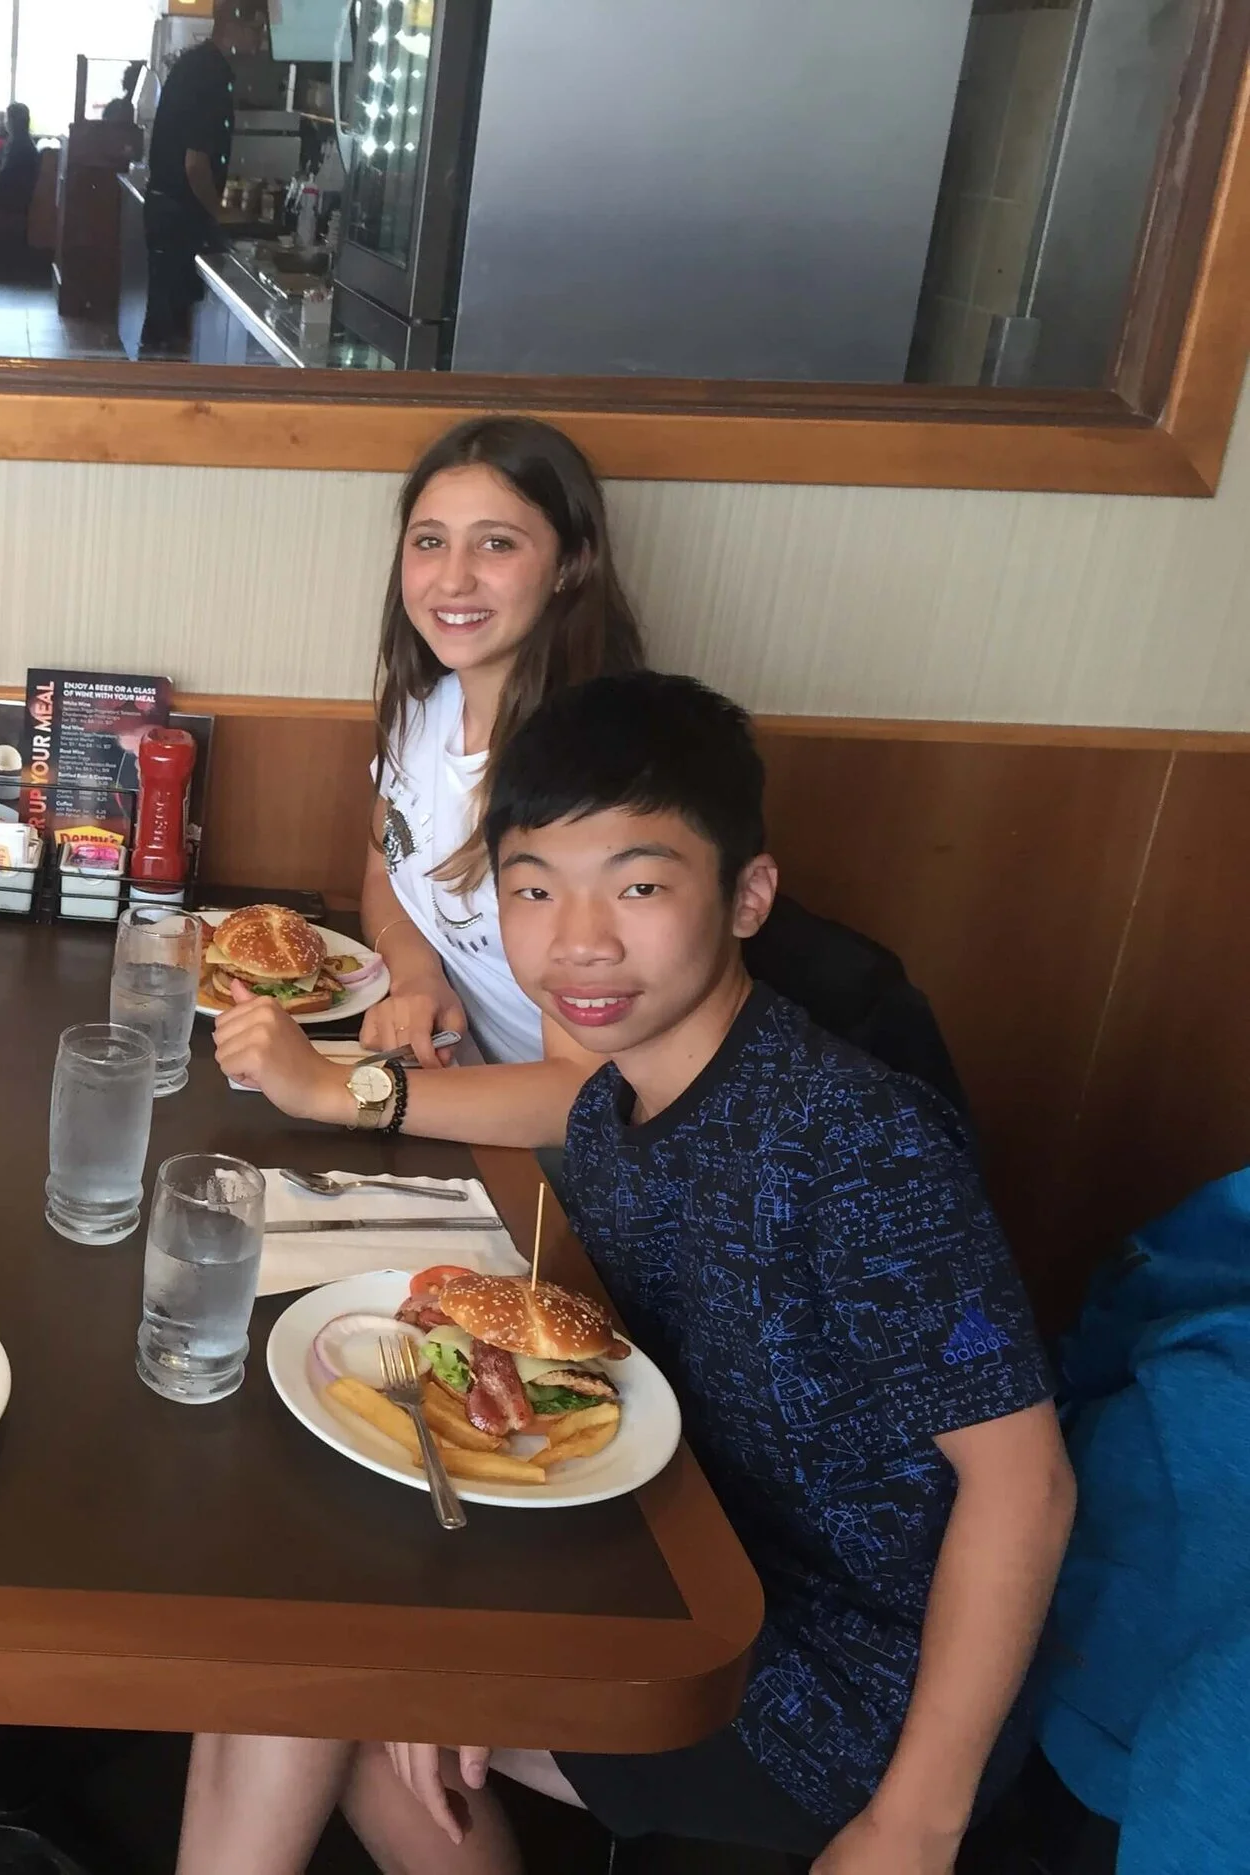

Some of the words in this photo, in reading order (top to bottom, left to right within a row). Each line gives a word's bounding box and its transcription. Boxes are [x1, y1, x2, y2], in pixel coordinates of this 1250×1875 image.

[64, 682, 87, 690] ENJOY
[95, 683, 113, 691] BEER
[115, 684, 126, 692] OR
[133, 686, 156, 694] GLASS
[114, 692, 135, 701] YOUR
[135, 694, 155, 703] MEAL
[34, 681, 54, 732] MEAL
[30, 735, 51, 784] YOUR
[29, 789, 47, 813] UP
[943, 1331, 1011, 1365] adidas
